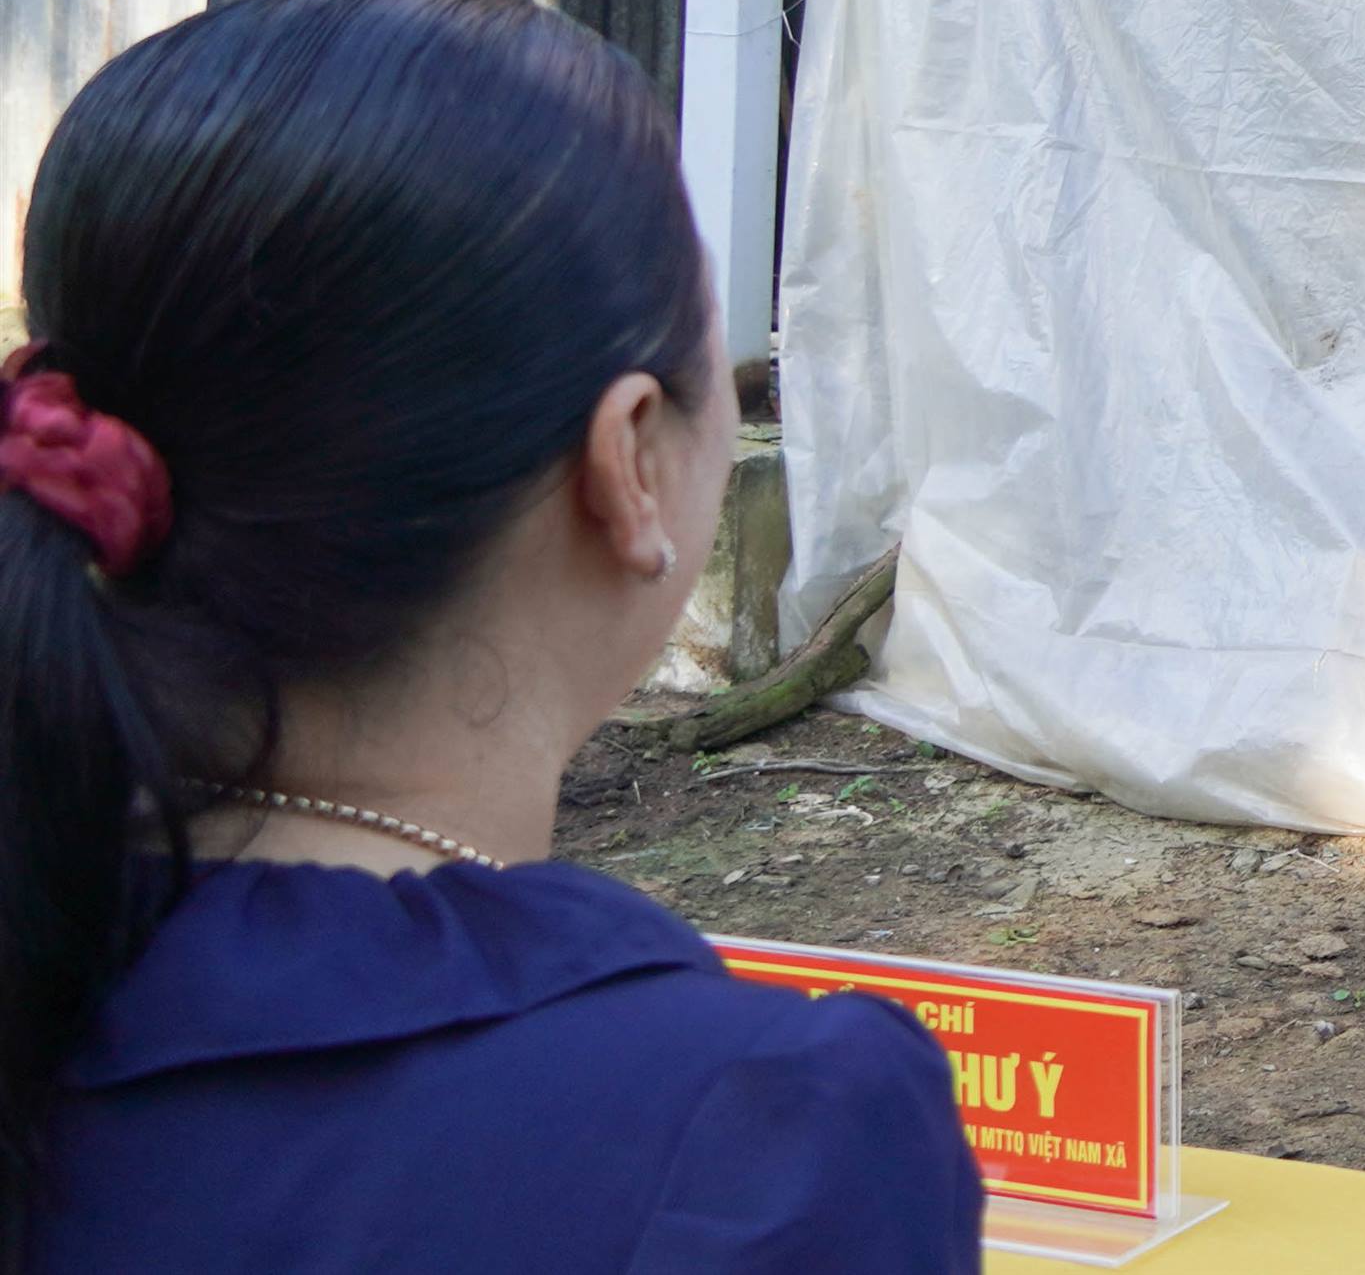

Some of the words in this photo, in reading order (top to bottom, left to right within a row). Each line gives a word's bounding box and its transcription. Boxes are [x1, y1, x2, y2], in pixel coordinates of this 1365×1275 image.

[917, 1002, 973, 1033] CHÍ
[949, 1051, 1019, 1111] HƯ
[1030, 1053, 1062, 1117] Ý
[981, 1127, 1023, 1154] MTTQ
[1028, 1130, 1062, 1163] VIỆT
[1066, 1140, 1100, 1163] NAM
[1104, 1141, 1127, 1168] XÃ
